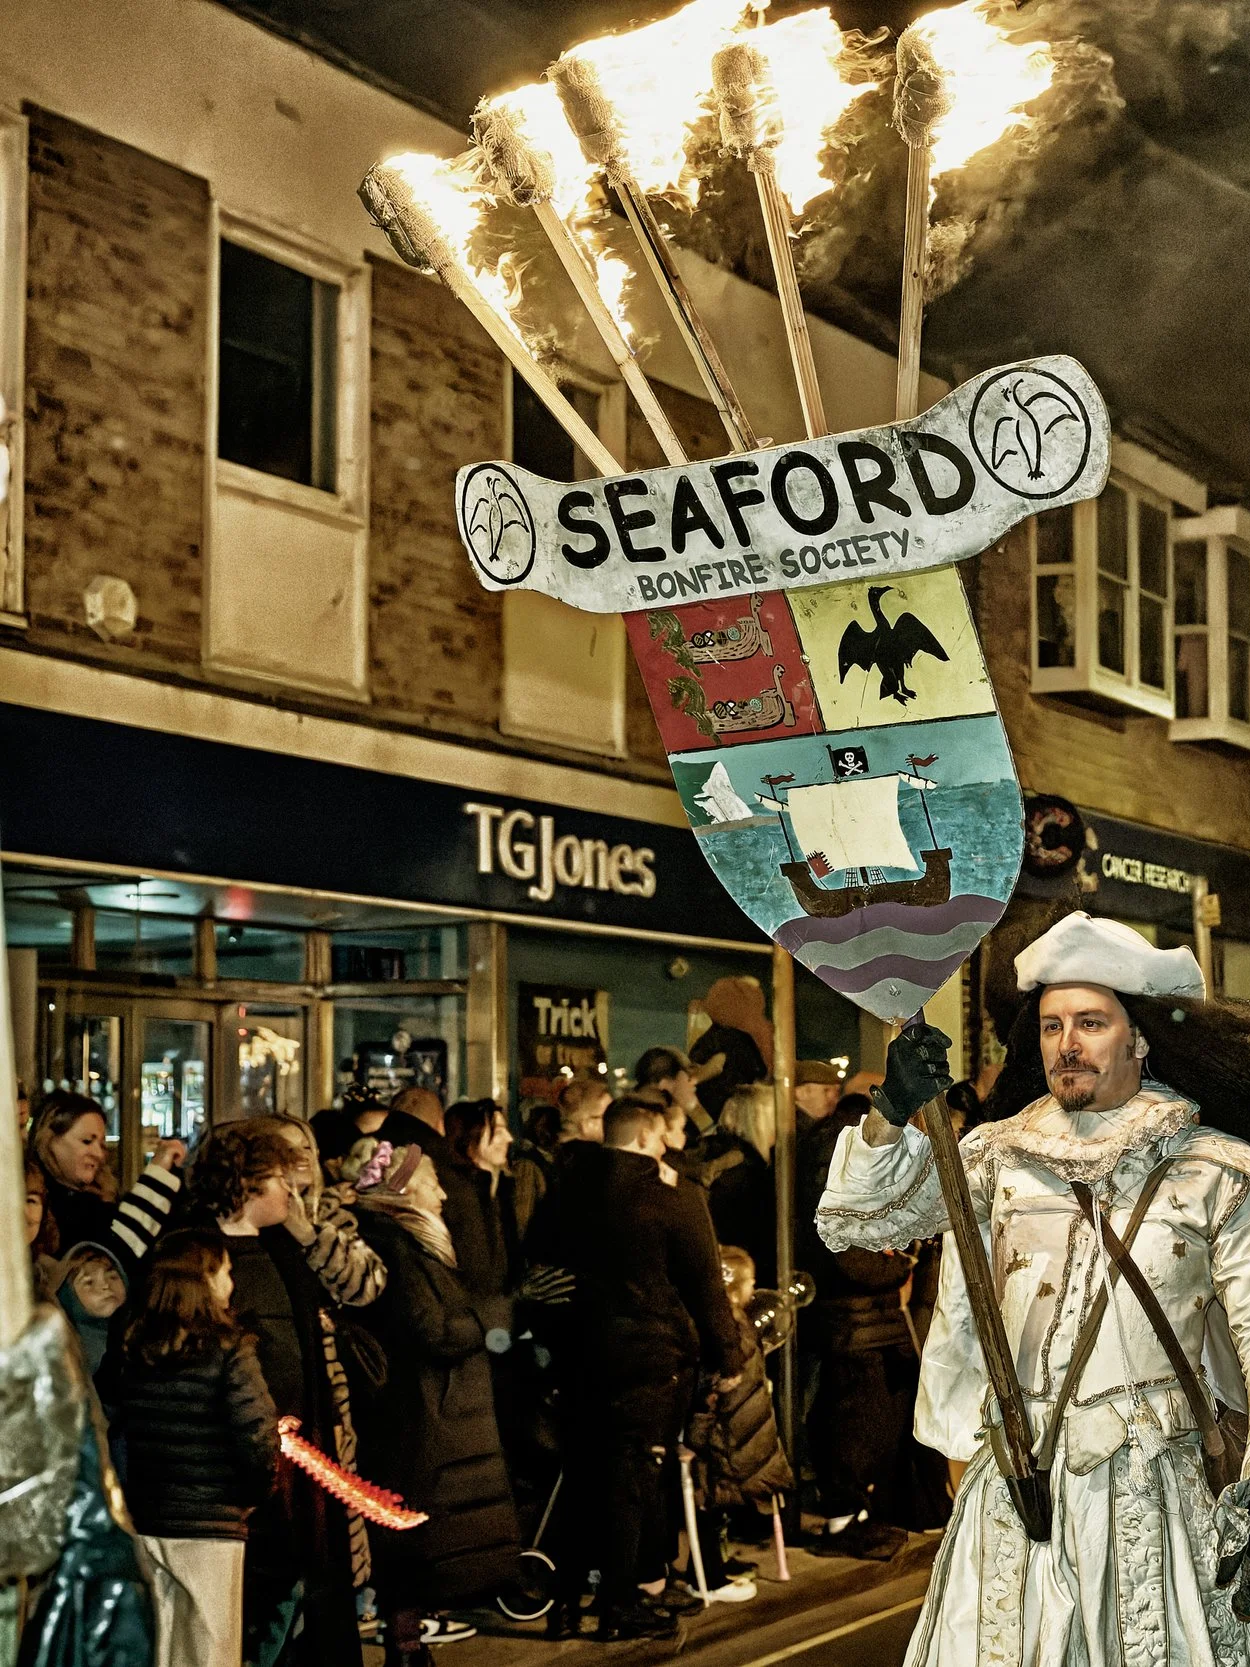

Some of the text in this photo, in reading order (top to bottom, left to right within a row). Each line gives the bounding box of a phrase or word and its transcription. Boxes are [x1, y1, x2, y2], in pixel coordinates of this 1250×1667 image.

[558, 431, 976, 570] SEAFORD
[637, 529, 910, 602] BONFIRE SOCIETY
[533, 996, 597, 1040] Trick
